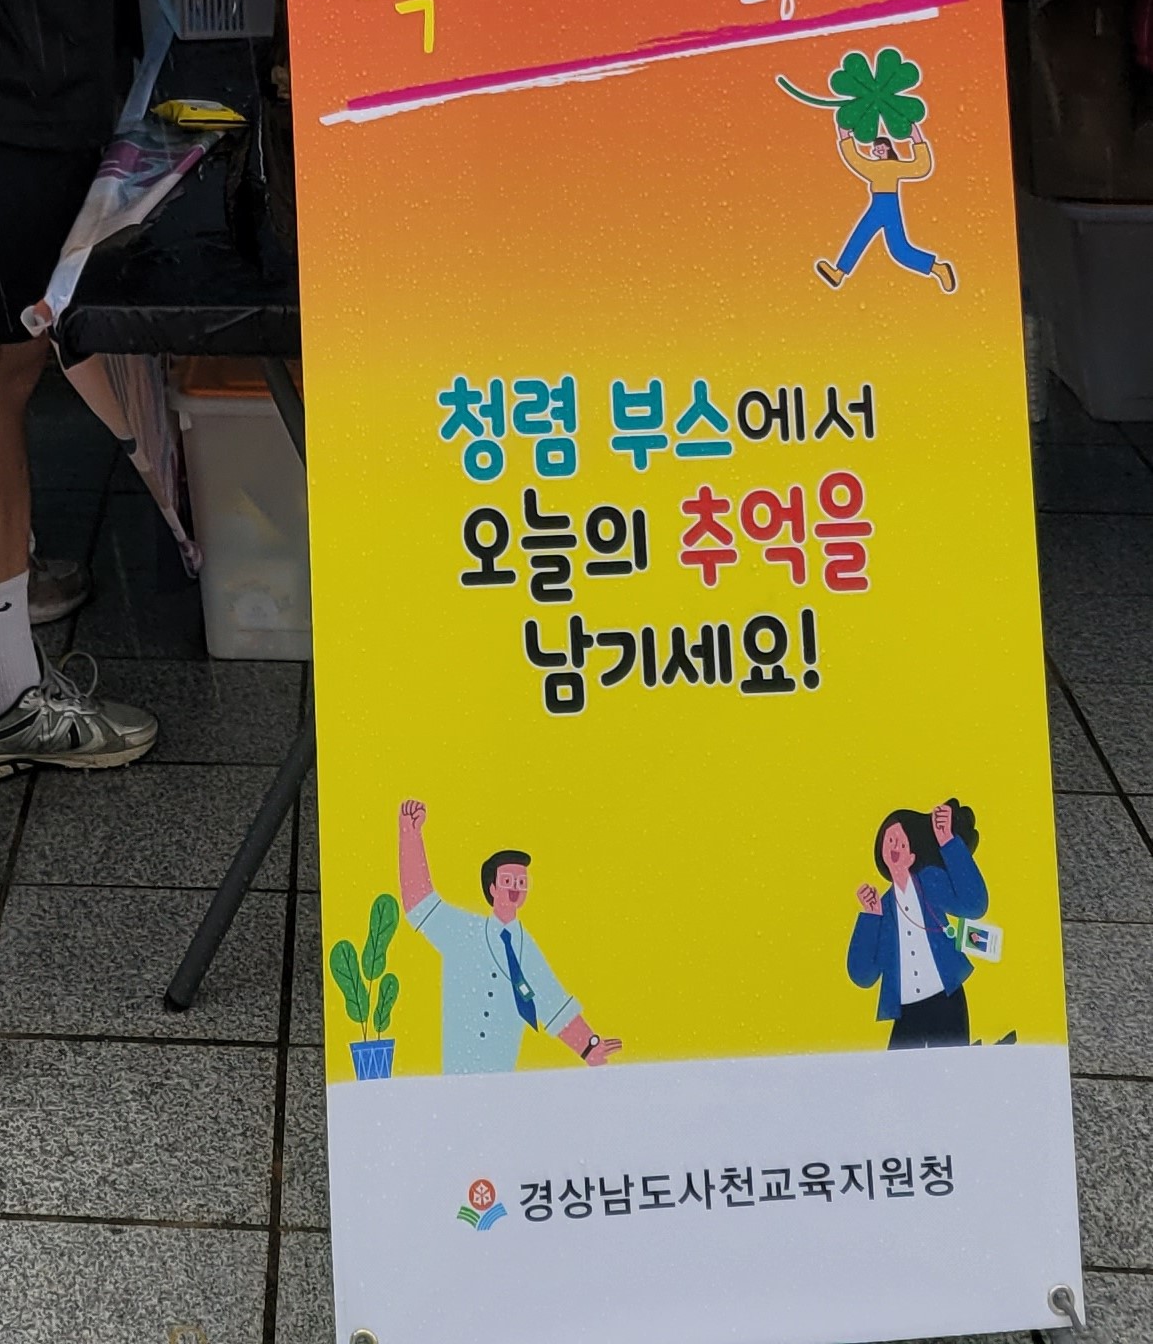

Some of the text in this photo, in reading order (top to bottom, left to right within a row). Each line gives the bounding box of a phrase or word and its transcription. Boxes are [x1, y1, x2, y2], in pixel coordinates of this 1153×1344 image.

[438, 374, 876, 483] 청렴 부스에서
[460, 471, 875, 603] 오늘의 추억을
[524, 608, 824, 716] 남기세요!
[518, 1153, 956, 1222] 경상남도사천교육지원청
